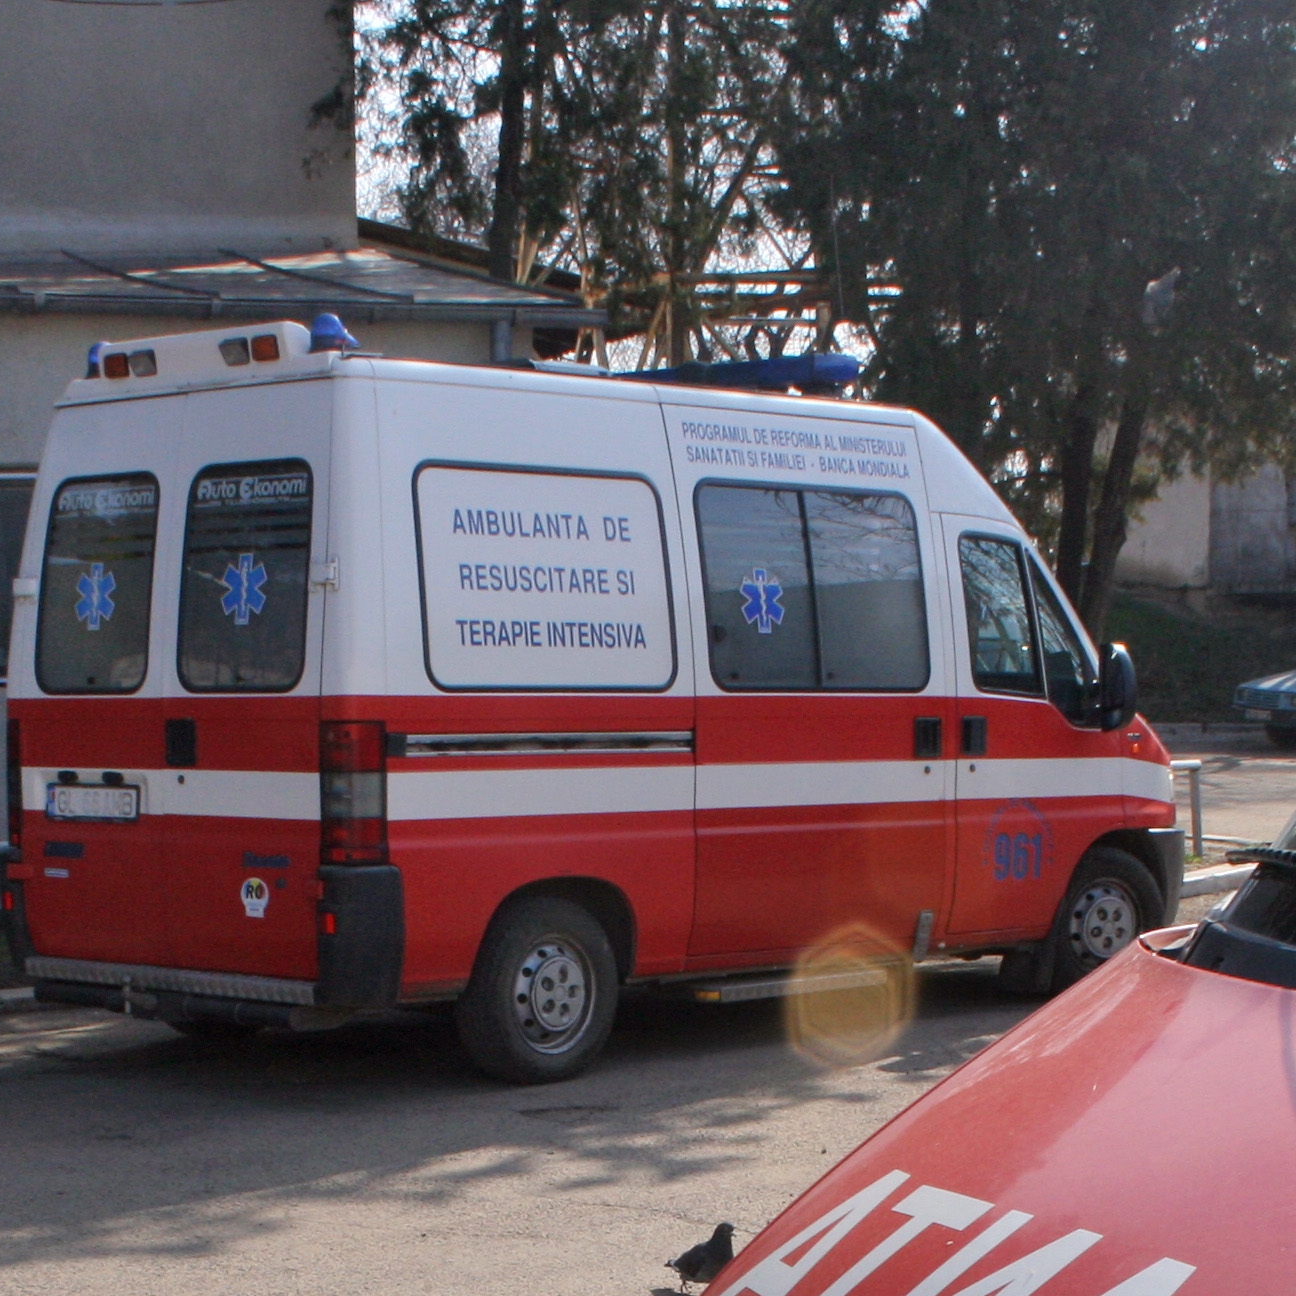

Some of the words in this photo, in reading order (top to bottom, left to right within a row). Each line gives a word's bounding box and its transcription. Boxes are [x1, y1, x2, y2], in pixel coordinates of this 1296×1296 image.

[681, 422, 753, 444] PROGRAMUL
[753, 428, 768, 445] DE
[770, 430, 821, 449] REFORMA
[824, 434, 838, 451] AL
[838, 436, 907, 457] MINISTERULUI
[686, 445, 746, 467] SANATATII
[747, 451, 758, 468] SI
[761, 451, 806, 471] FAMILIEI
[819, 456, 856, 474] BANCA
[858, 460, 910, 479] MONDIALA
[197, 480, 236, 501] Auto
[453, 508, 590, 541] AMBULANTA
[603, 516, 632, 542] DE
[459, 564, 610, 594] RESUSCITARE
[616, 570, 635, 595] SI
[455, 619, 542, 647] TERAPIE
[547, 622, 647, 649] INTENSIVA
[993, 832, 1042, 880] 961
[245, 882, 263, 900] RO
